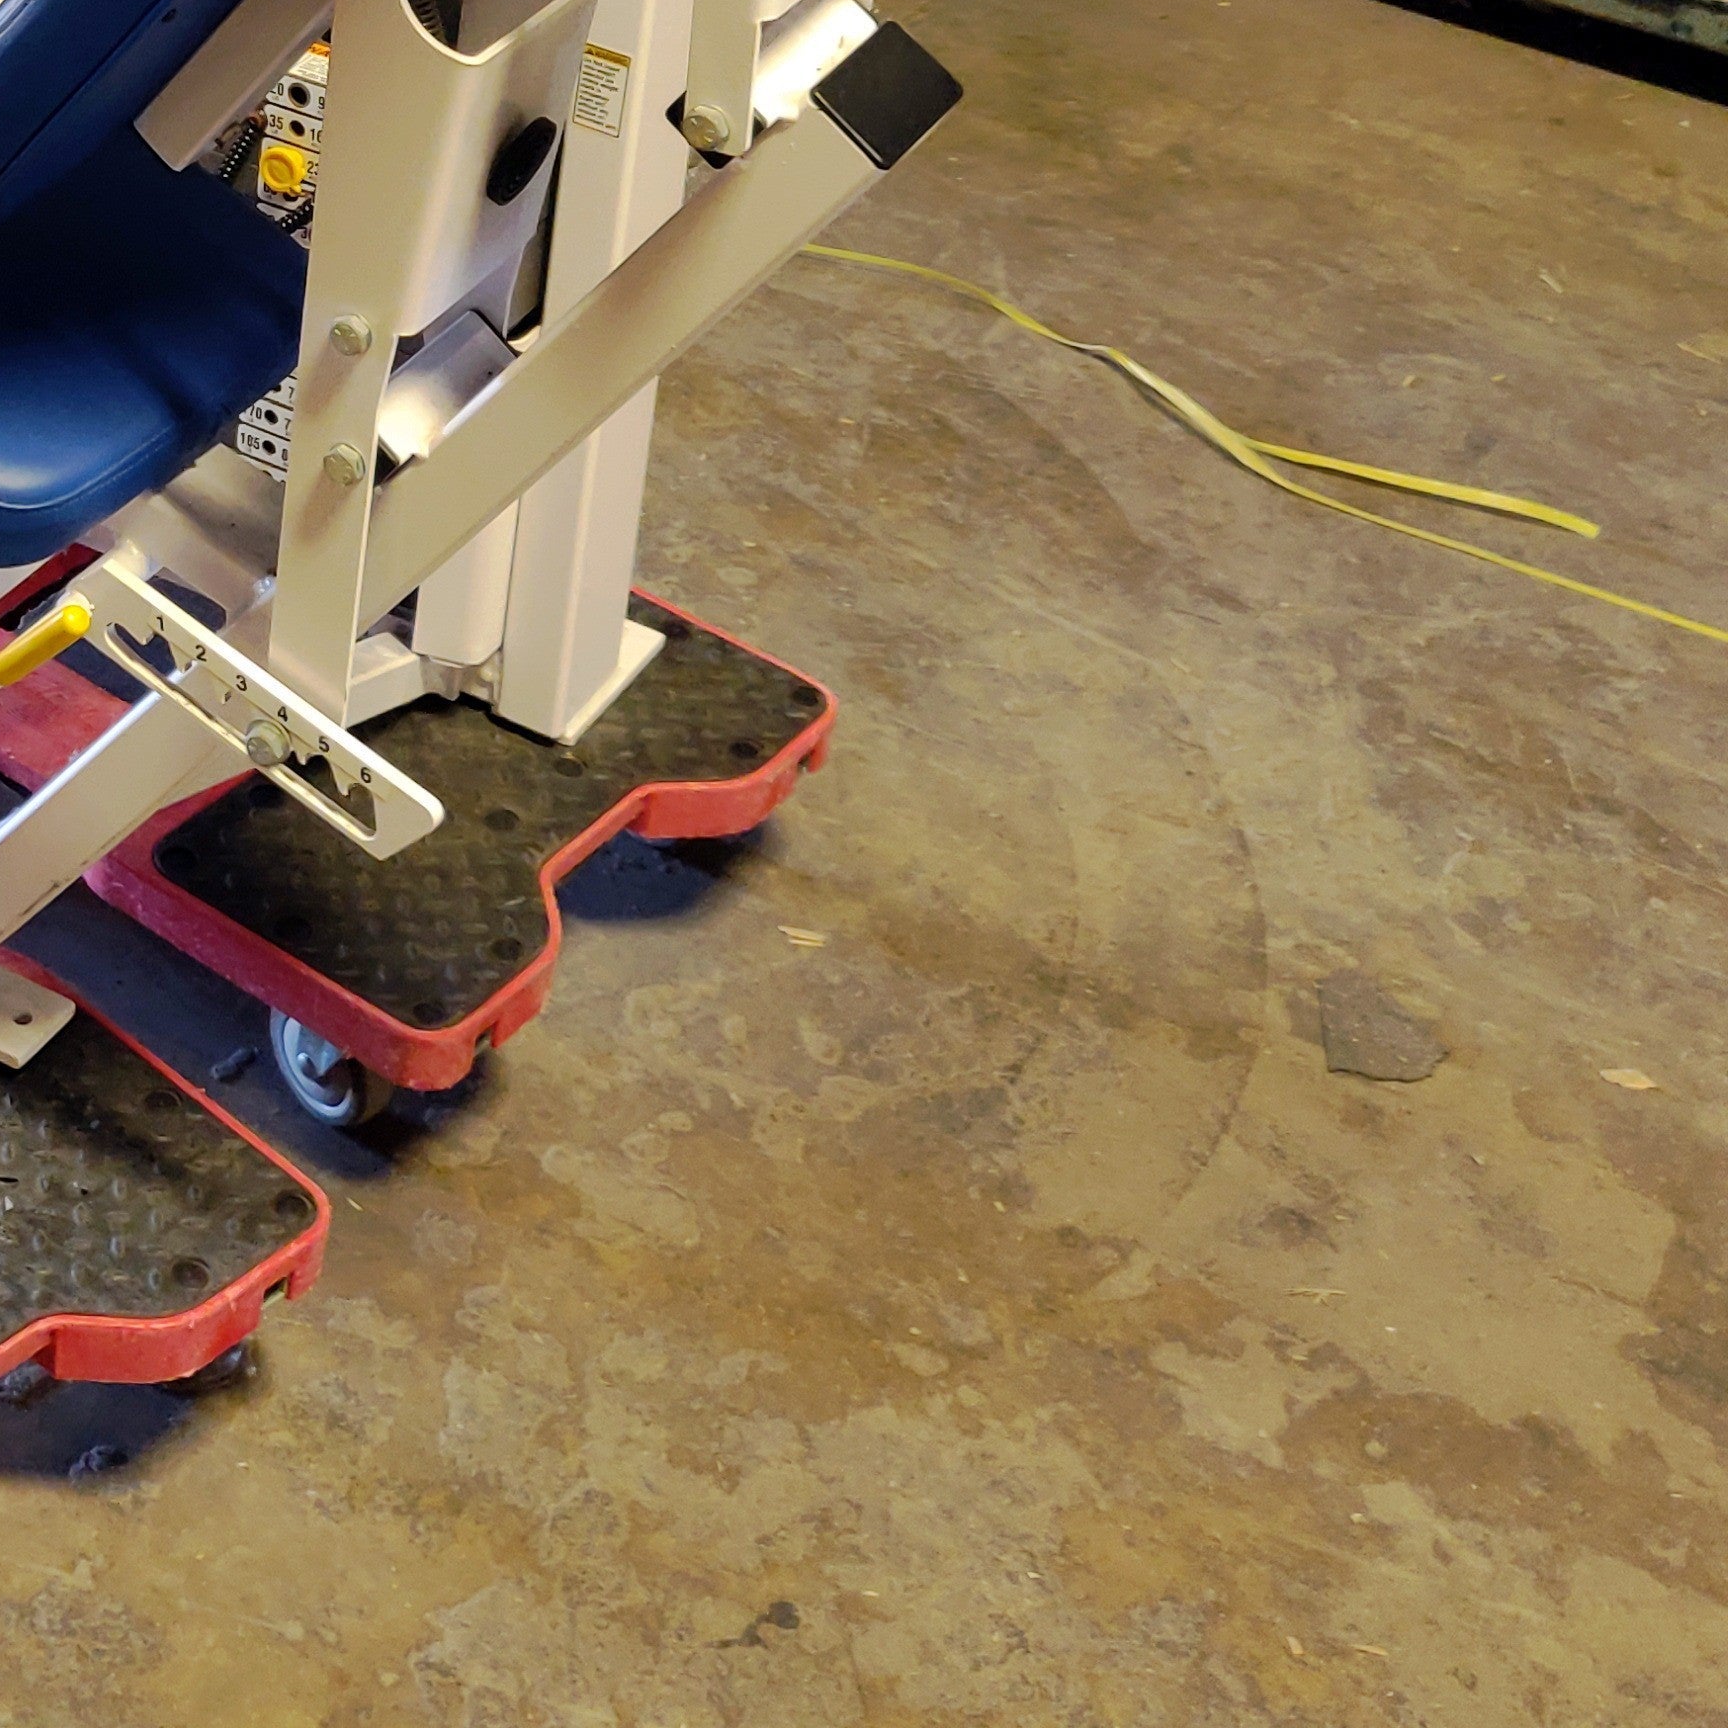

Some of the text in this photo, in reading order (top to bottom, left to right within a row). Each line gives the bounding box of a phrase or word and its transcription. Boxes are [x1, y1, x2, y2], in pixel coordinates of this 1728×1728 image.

[269, 114, 284, 130] 35
[156, 615, 164, 631] 1
[195, 644, 207, 662] 2
[236, 674, 247, 692] 3
[277, 706, 288, 722] 4
[319, 735, 330, 753] 5
[360, 766, 371, 784] 6
